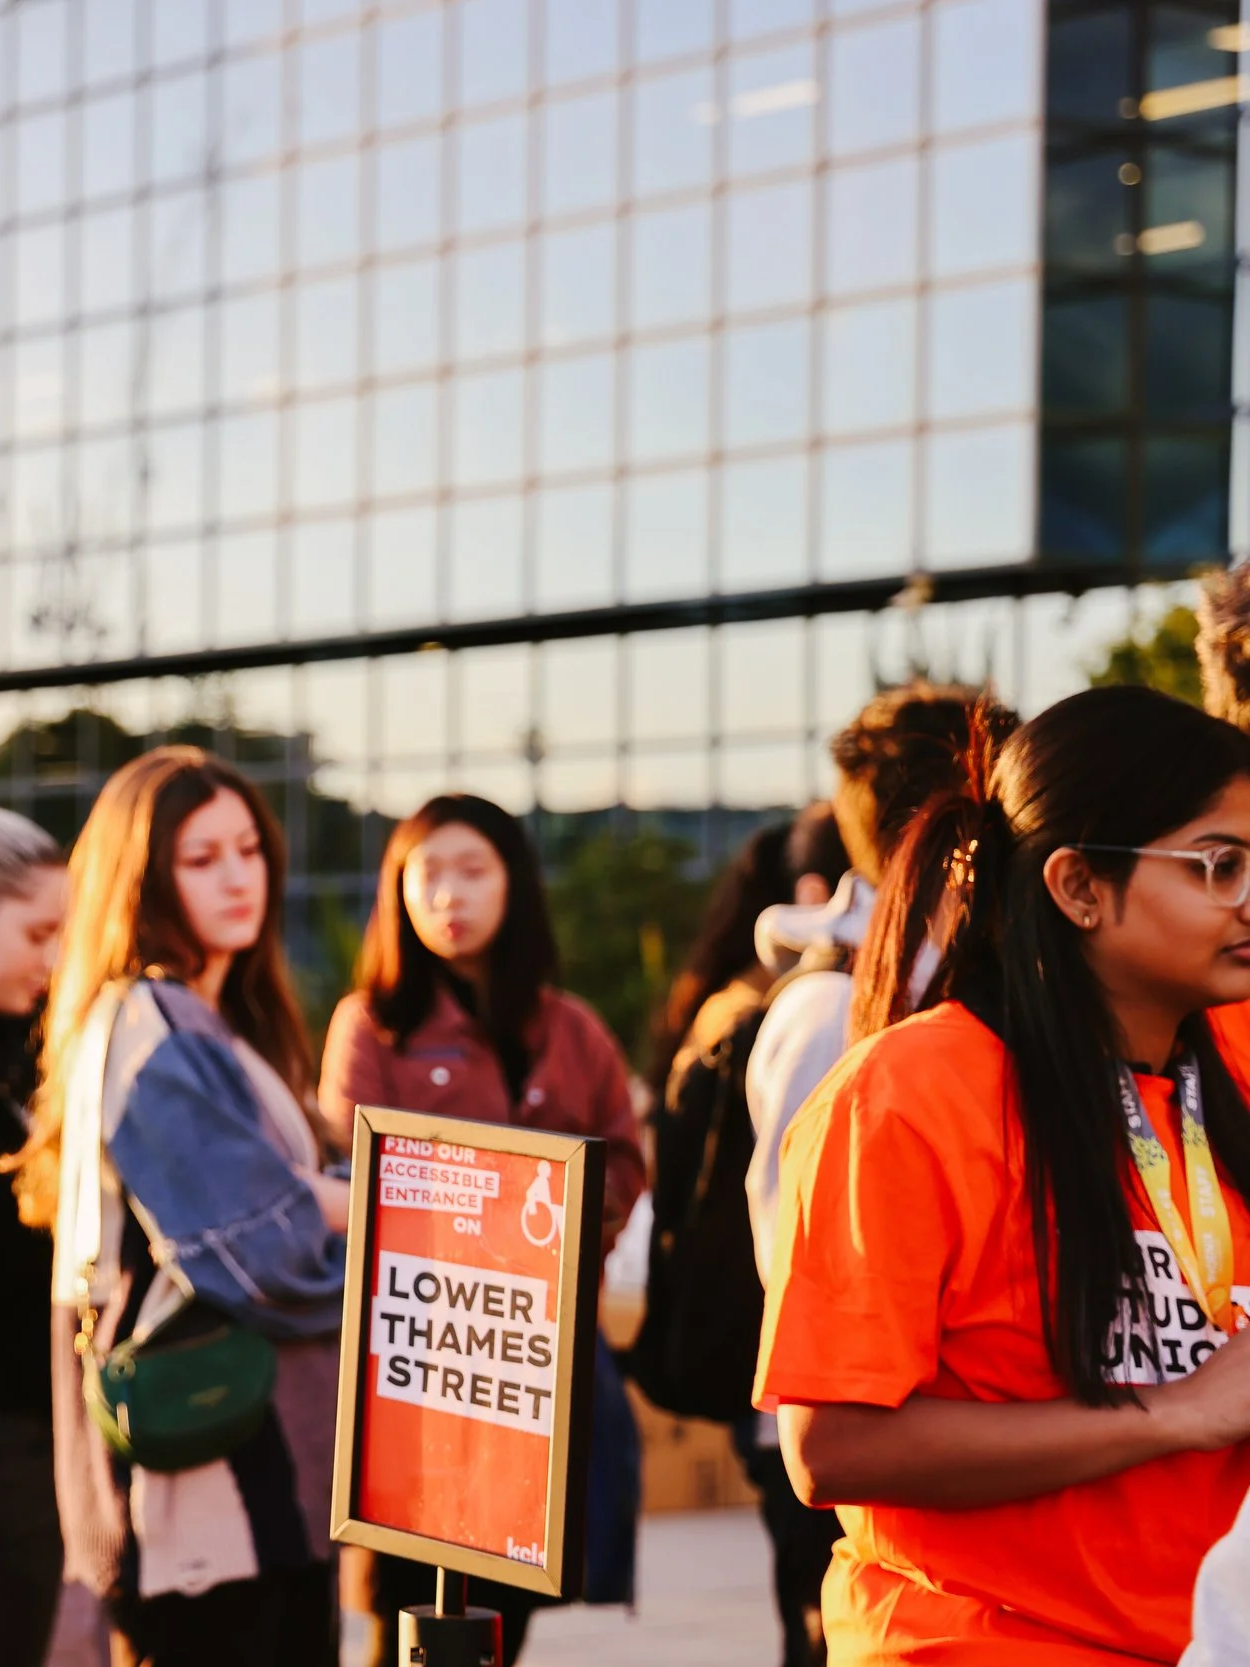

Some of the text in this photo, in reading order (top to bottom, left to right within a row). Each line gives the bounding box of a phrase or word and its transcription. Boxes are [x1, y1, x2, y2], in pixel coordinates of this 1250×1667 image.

[385, 1136, 476, 1164] FIND OUR
[383, 1162, 495, 1191] ACCESSIBLE
[385, 1187, 478, 1208] ENTRANCE
[453, 1216, 482, 1236] ON
[389, 1266, 534, 1324] LOWER
[380, 1312, 552, 1368] THAMES
[386, 1355, 552, 1420] STREET
